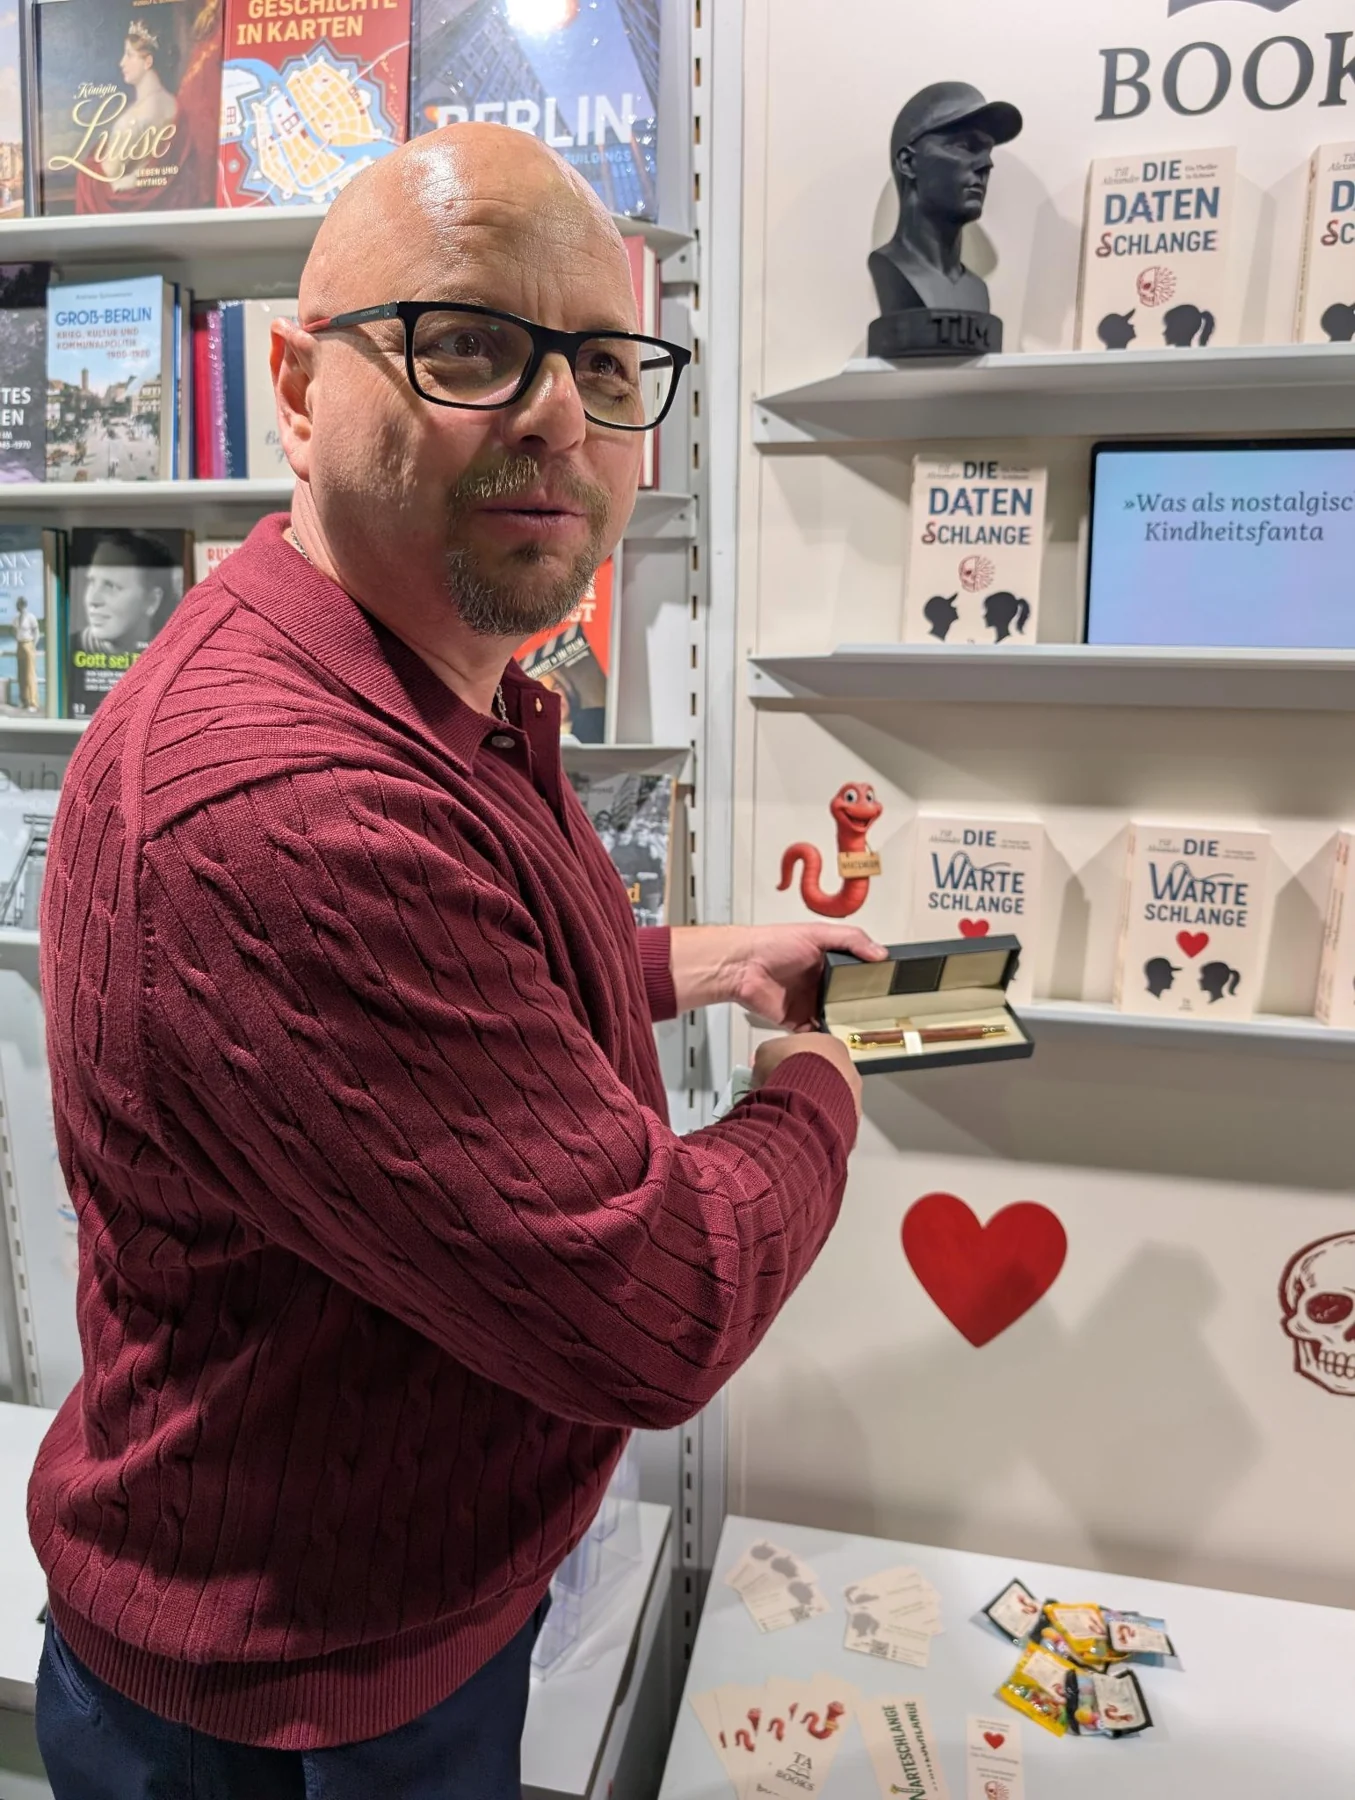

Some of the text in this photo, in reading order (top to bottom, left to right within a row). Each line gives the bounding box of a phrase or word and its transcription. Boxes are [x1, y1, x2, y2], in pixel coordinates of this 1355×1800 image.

[236, 15, 364, 45] IN KARTEN
[73, 81, 119, 100] Königin
[49, 92, 177, 183] Luise
[136, 164, 179, 177] LEBEN UND
[136, 177, 168, 187] MYTHOS
[1142, 159, 1182, 183] DIE
[1103, 186, 1220, 226] DATEN
[1095, 230, 1218, 258] SCHLANGE
[87, 328, 118, 338] KULTUR
[120, 326, 139, 336] UND
[56, 339, 137, 351] KOMMUNALPOLITIK
[963, 461, 998, 480] DIE
[928, 486, 1033, 517] DATEN
[1123, 490, 1355, 517] »Was als nostalgisc
[921, 521, 1032, 546] SCHLANGE
[1144, 520, 1325, 547] Kindheitsfanta
[74, 651, 107, 669] Gott
[108, 652, 130, 669] sei
[962, 828, 997, 848] DIE
[1183, 838, 1220, 858] DIE
[930, 850, 1026, 894] WARTE
[1148, 860, 1250, 907] WARTE
[927, 892, 1025, 915] SCHLANGE
[1144, 903, 1248, 928] SCHLANGE
